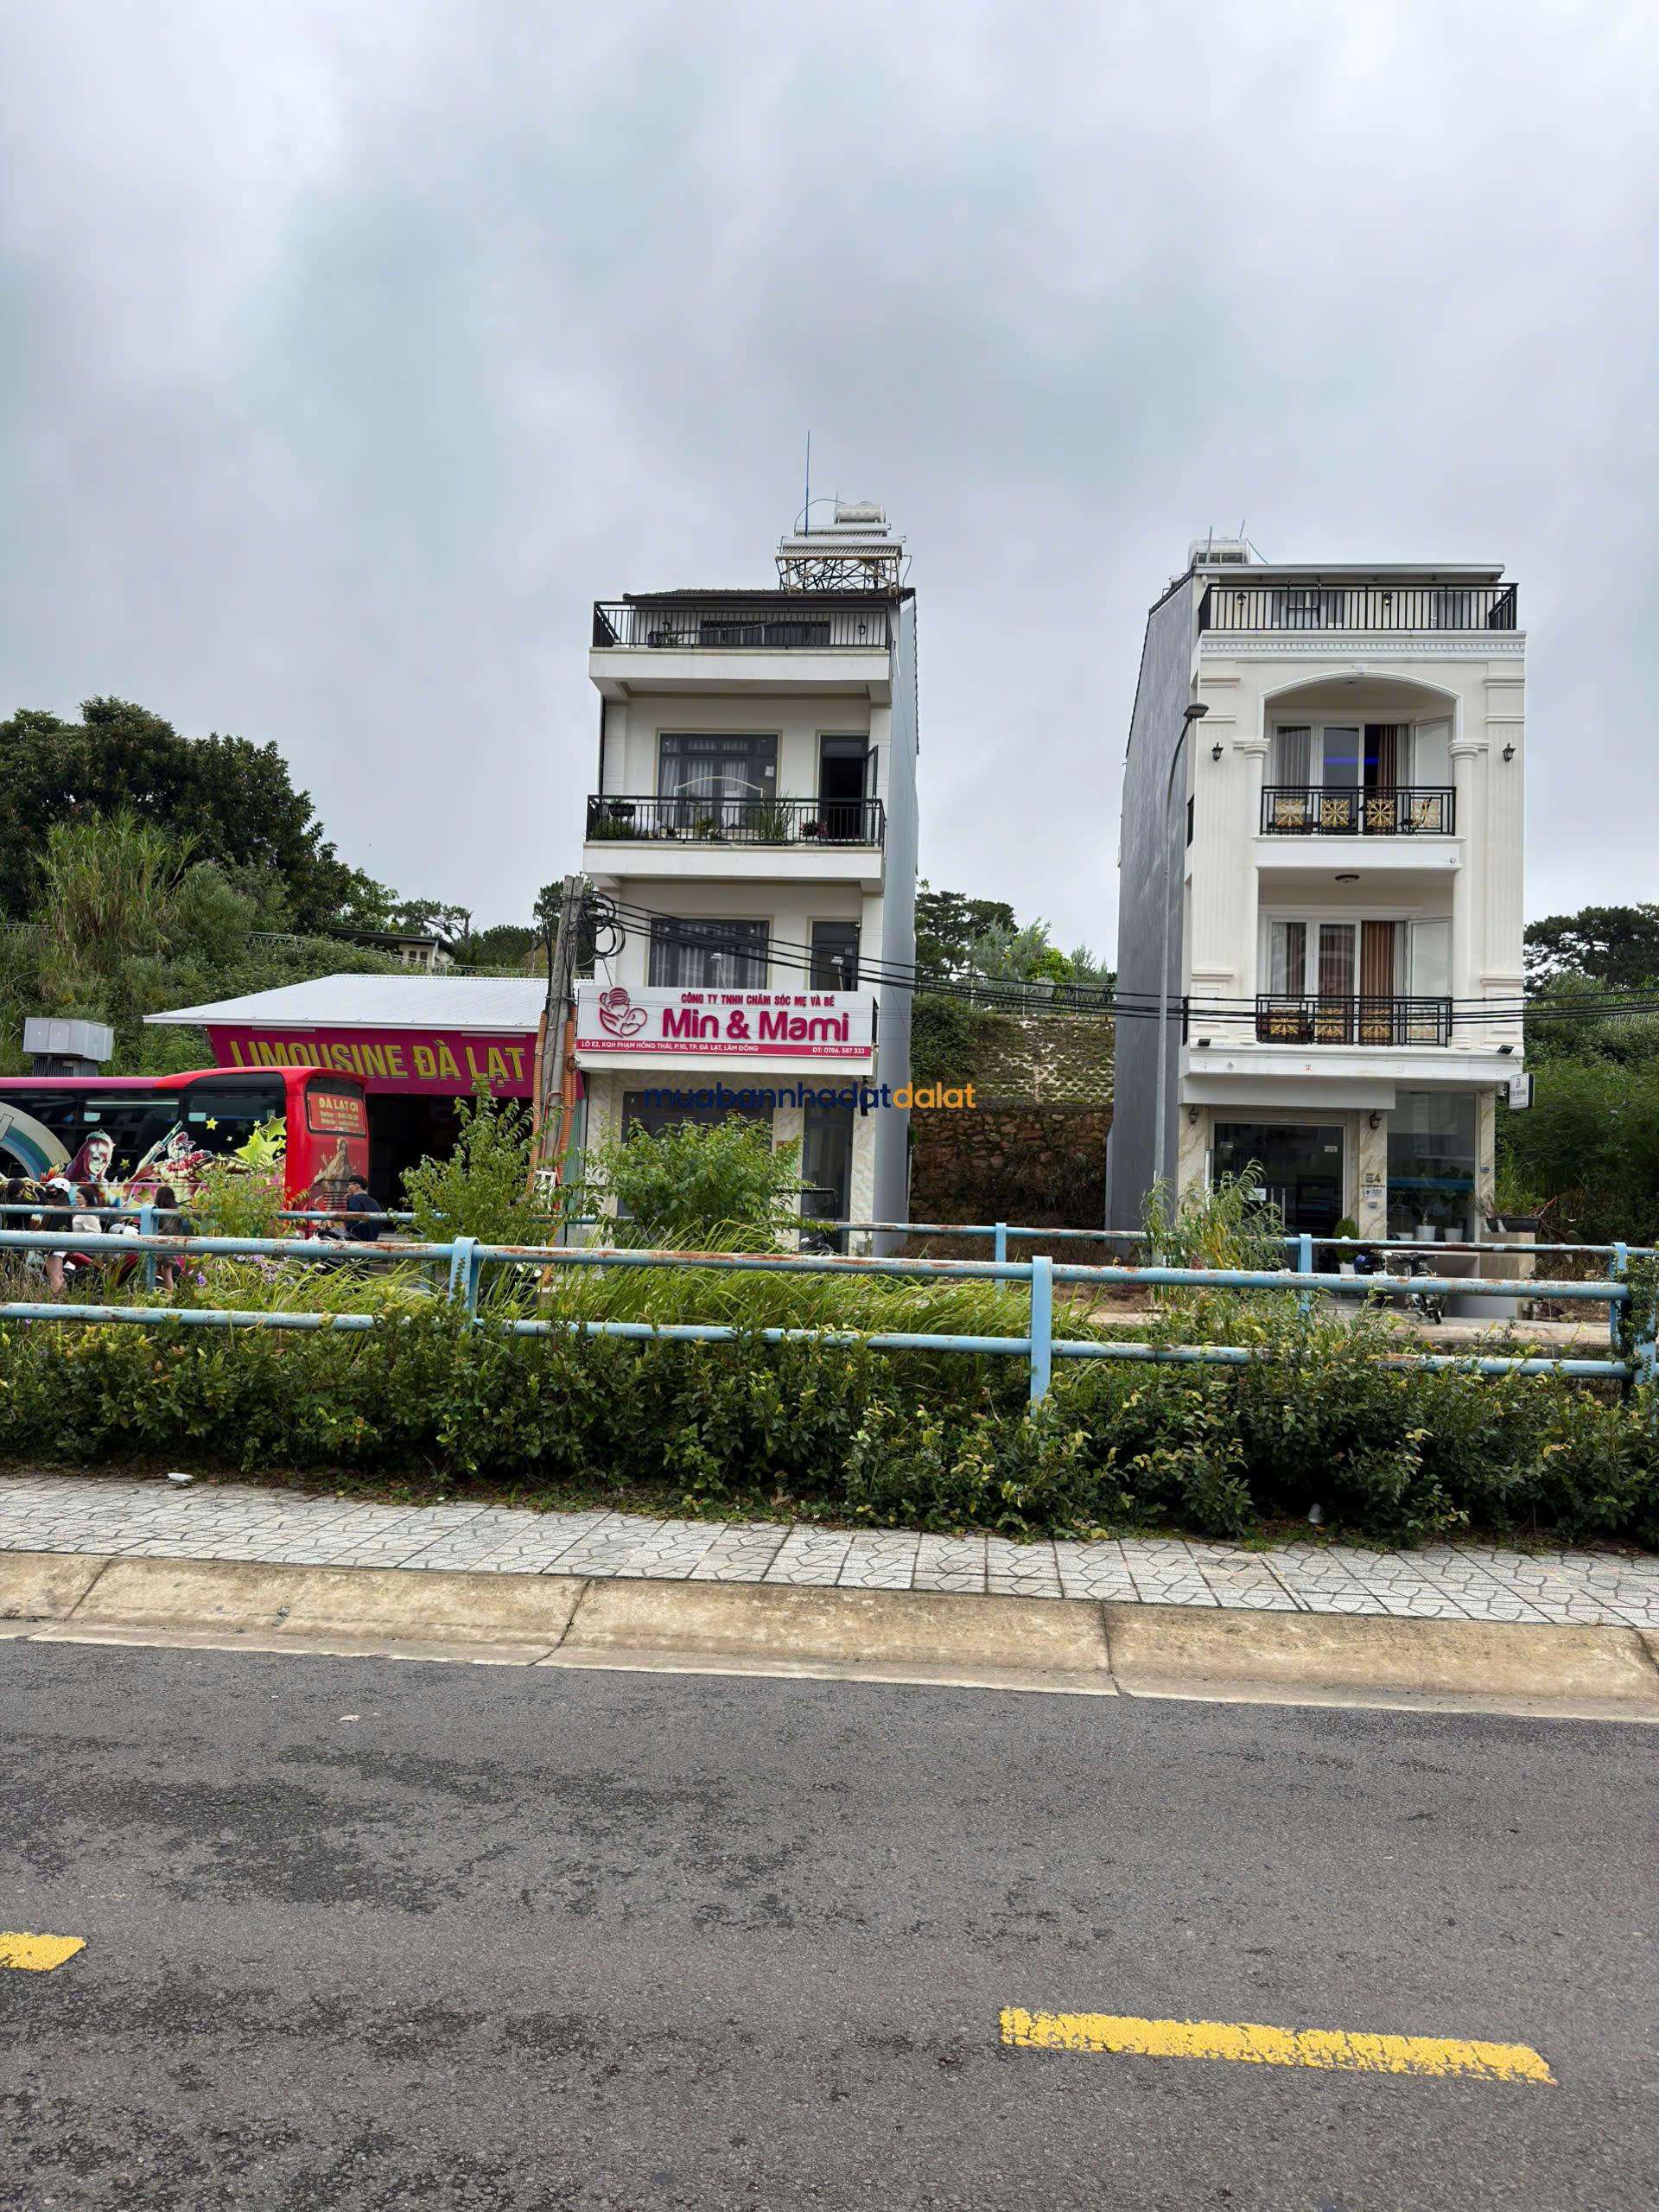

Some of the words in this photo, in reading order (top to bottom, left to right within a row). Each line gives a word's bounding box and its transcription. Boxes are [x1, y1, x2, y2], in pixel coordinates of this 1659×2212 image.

[681, 992, 703, 1004] CÔNG
[707, 994, 718, 1004] TY
[721, 995, 743, 1005] TNHH
[747, 994, 771, 1005] CHĂM
[774, 994, 791, 1006] SÓC
[794, 995, 806, 1007] MẸ
[810, 994, 821, 1007] VÀ
[824, 995, 835, 1007] BÉ
[663, 1008, 719, 1039] Min
[727, 1010, 751, 1039] &
[759, 1011, 849, 1041] Mami
[230, 1039, 410, 1078] LIMOUSINE
[414, 1039, 461, 1079] ĐÀ
[465, 1046, 525, 1086] LẠT
